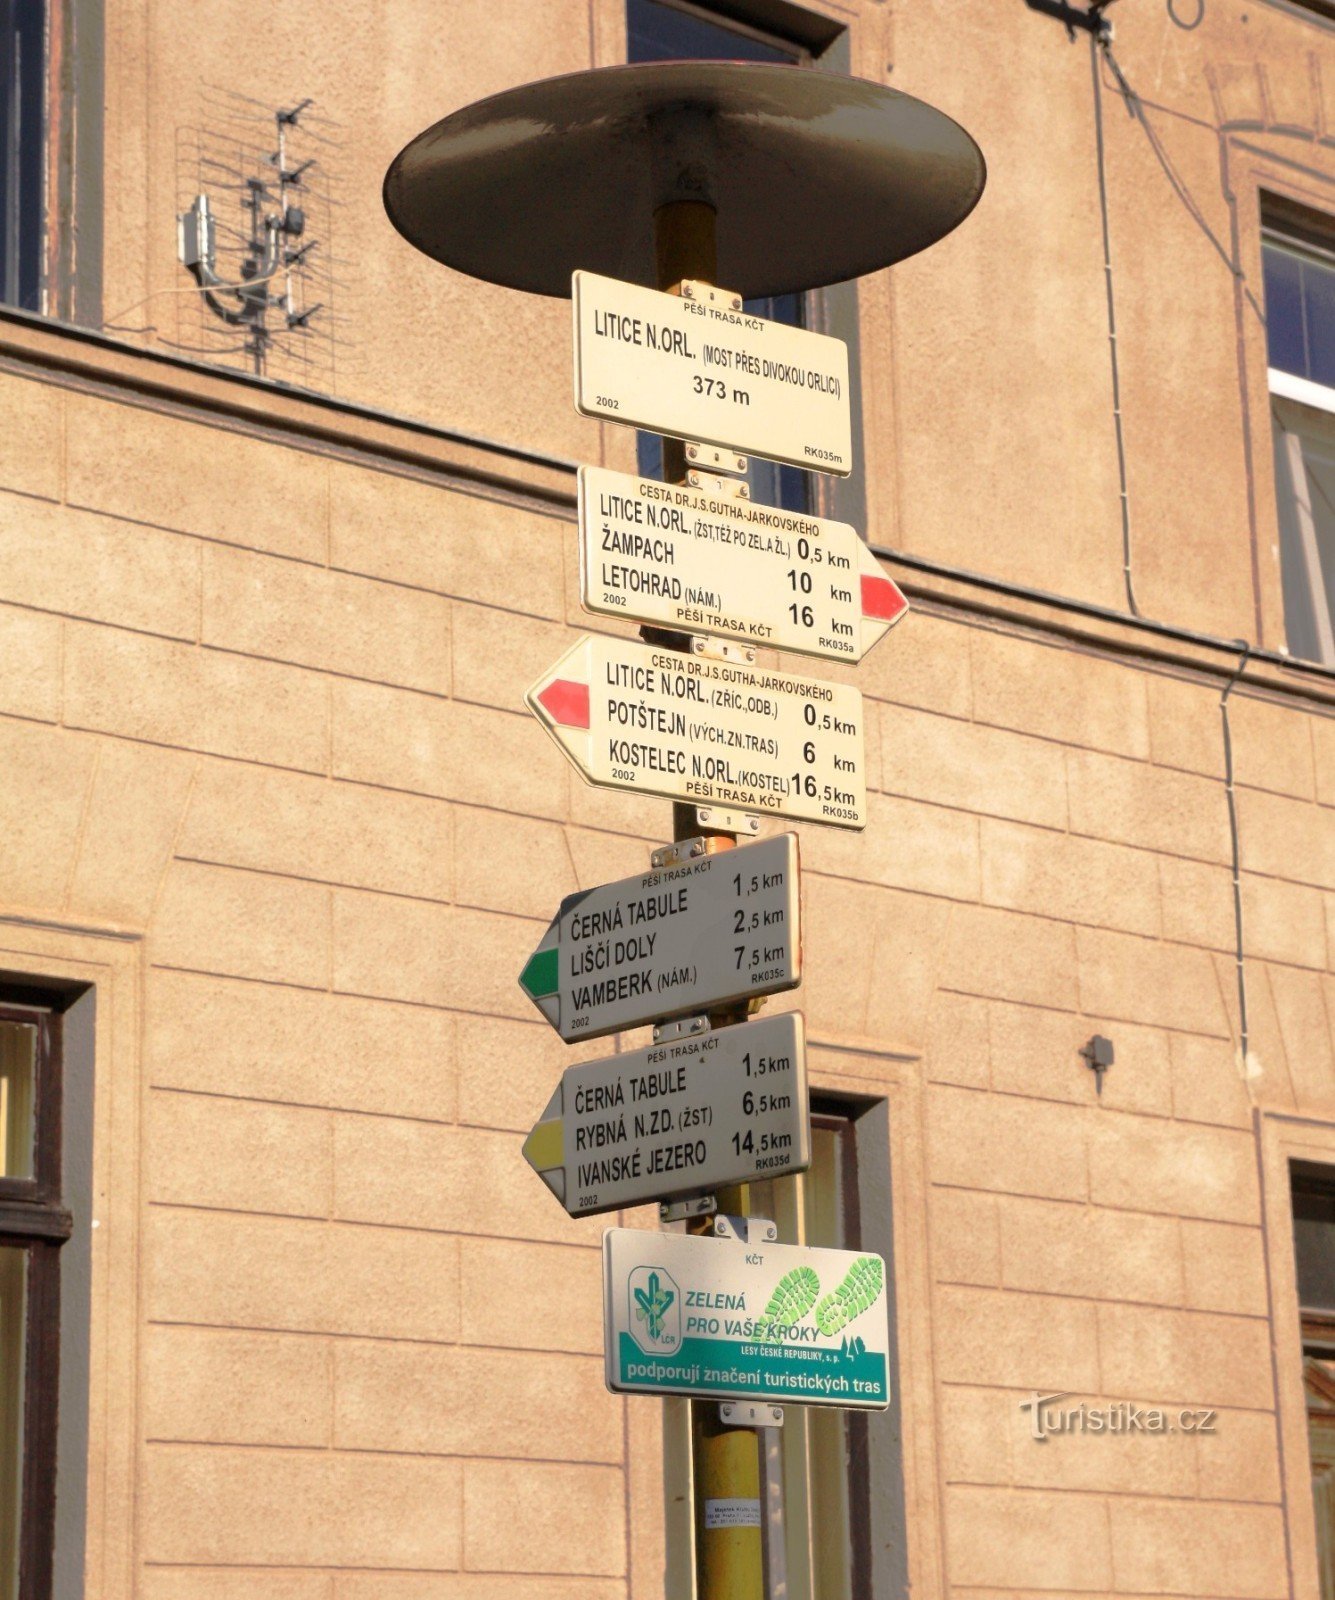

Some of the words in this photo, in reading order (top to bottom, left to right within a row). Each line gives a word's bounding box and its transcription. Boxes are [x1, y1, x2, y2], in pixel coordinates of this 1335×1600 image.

[684, 302, 706, 315] PĚŠÍ
[709, 309, 742, 326] TRASA
[745, 318, 765, 331] KČT
[595, 309, 641, 346] LITICE
[647, 323, 696, 359] N.ORL.
[703, 344, 732, 367] (MOST
[735, 351, 760, 375] PŘES
[762, 360, 805, 387] DIVOKOU
[807, 371, 840, 400] ORLICI)
[596, 396, 619, 409] 2002
[693, 376, 727, 399] 373
[733, 389, 749, 405] m
[804, 446, 842, 463] RK035m
[640, 484, 673, 502] CESTA
[600, 493, 642, 522] LITICE
[647, 505, 691, 534] N.ORL.
[734, 532, 746, 546] PO
[797, 538, 822, 564] 0,5
[827, 551, 850, 569] km
[602, 523, 674, 565] ŽAMPACH
[787, 569, 812, 594] 10
[830, 585, 851, 602] km
[602, 563, 681, 600] LETOHRAD
[685, 588, 721, 611] (NÁM.)
[789, 603, 814, 628] 16
[832, 619, 853, 636] km
[603, 593, 627, 606] 2002
[677, 608, 704, 623] PĚŠÍ
[708, 614, 745, 632] TRASA
[749, 623, 772, 637] KČT
[652, 654, 684, 673] CESTA
[819, 637, 854, 652] RK035a
[606, 662, 655, 692] LITICE
[661, 675, 709, 703] N.ORL.
[804, 704, 831, 730] 0,5
[834, 717, 856, 735] km
[608, 699, 686, 737] POTŠTEJN
[803, 742, 815, 764] 6
[834, 755, 855, 773] km
[609, 739, 686, 774] KOSTELEC
[692, 757, 738, 785] N.ORL.
[738, 770, 790, 796] (KOSTEL)
[791, 773, 832, 801] 16,5
[834, 792, 855, 805] km
[612, 768, 635, 781] 2002
[686, 781, 713, 796] PĚŠÍ
[717, 787, 755, 803] TRASA
[759, 795, 782, 808] KČT
[823, 805, 859, 821] RK035b
[663, 866, 692, 883] TRASA
[694, 860, 712, 873] KČT
[571, 902, 623, 941] ČERNÁ
[628, 889, 688, 925] TABULE
[734, 873, 759, 896] 1,5
[763, 873, 783, 889] km
[572, 941, 611, 977] LIŠČÍ
[615, 932, 657, 965] DOLY
[734, 910, 759, 934] 2,5
[764, 909, 783, 925] km
[572, 970, 653, 1011] VAMBERK
[658, 966, 696, 993] (NÁM.)
[735, 946, 760, 970] 7,5
[764, 947, 784, 963] km
[572, 1016, 590, 1029] 2002
[752, 969, 785, 984] RK035c
[670, 1045, 699, 1059] TRASA
[702, 1038, 719, 1051] KČT
[575, 1077, 624, 1115] ČERNÁ
[630, 1067, 686, 1102] TABULE
[743, 1053, 767, 1077] 1,5
[769, 1056, 789, 1072] km
[576, 1114, 627, 1151] RYBNÁ
[635, 1109, 674, 1138] N.ZD.
[679, 1106, 713, 1132] (ŽST)
[743, 1091, 767, 1116] 6,5
[770, 1095, 790, 1110] km
[578, 1148, 641, 1188] IVANSKÉ
[647, 1140, 707, 1175] JEZERO
[732, 1130, 768, 1156] 14,5
[771, 1133, 791, 1148] km
[579, 1195, 598, 1207] 2002
[755, 1156, 790, 1170] RK035d
[745, 1254, 763, 1265] KČT
[685, 1291, 746, 1311] ZELENÁ
[687, 1318, 719, 1334] PRO
[725, 1319, 763, 1337] VAŠE
[766, 1324, 820, 1342] KROKY
[741, 1346, 758, 1356] LESY
[628, 1362, 700, 1384] podporují
[764, 1371, 848, 1394] turistických
[853, 1378, 881, 1394] tras
